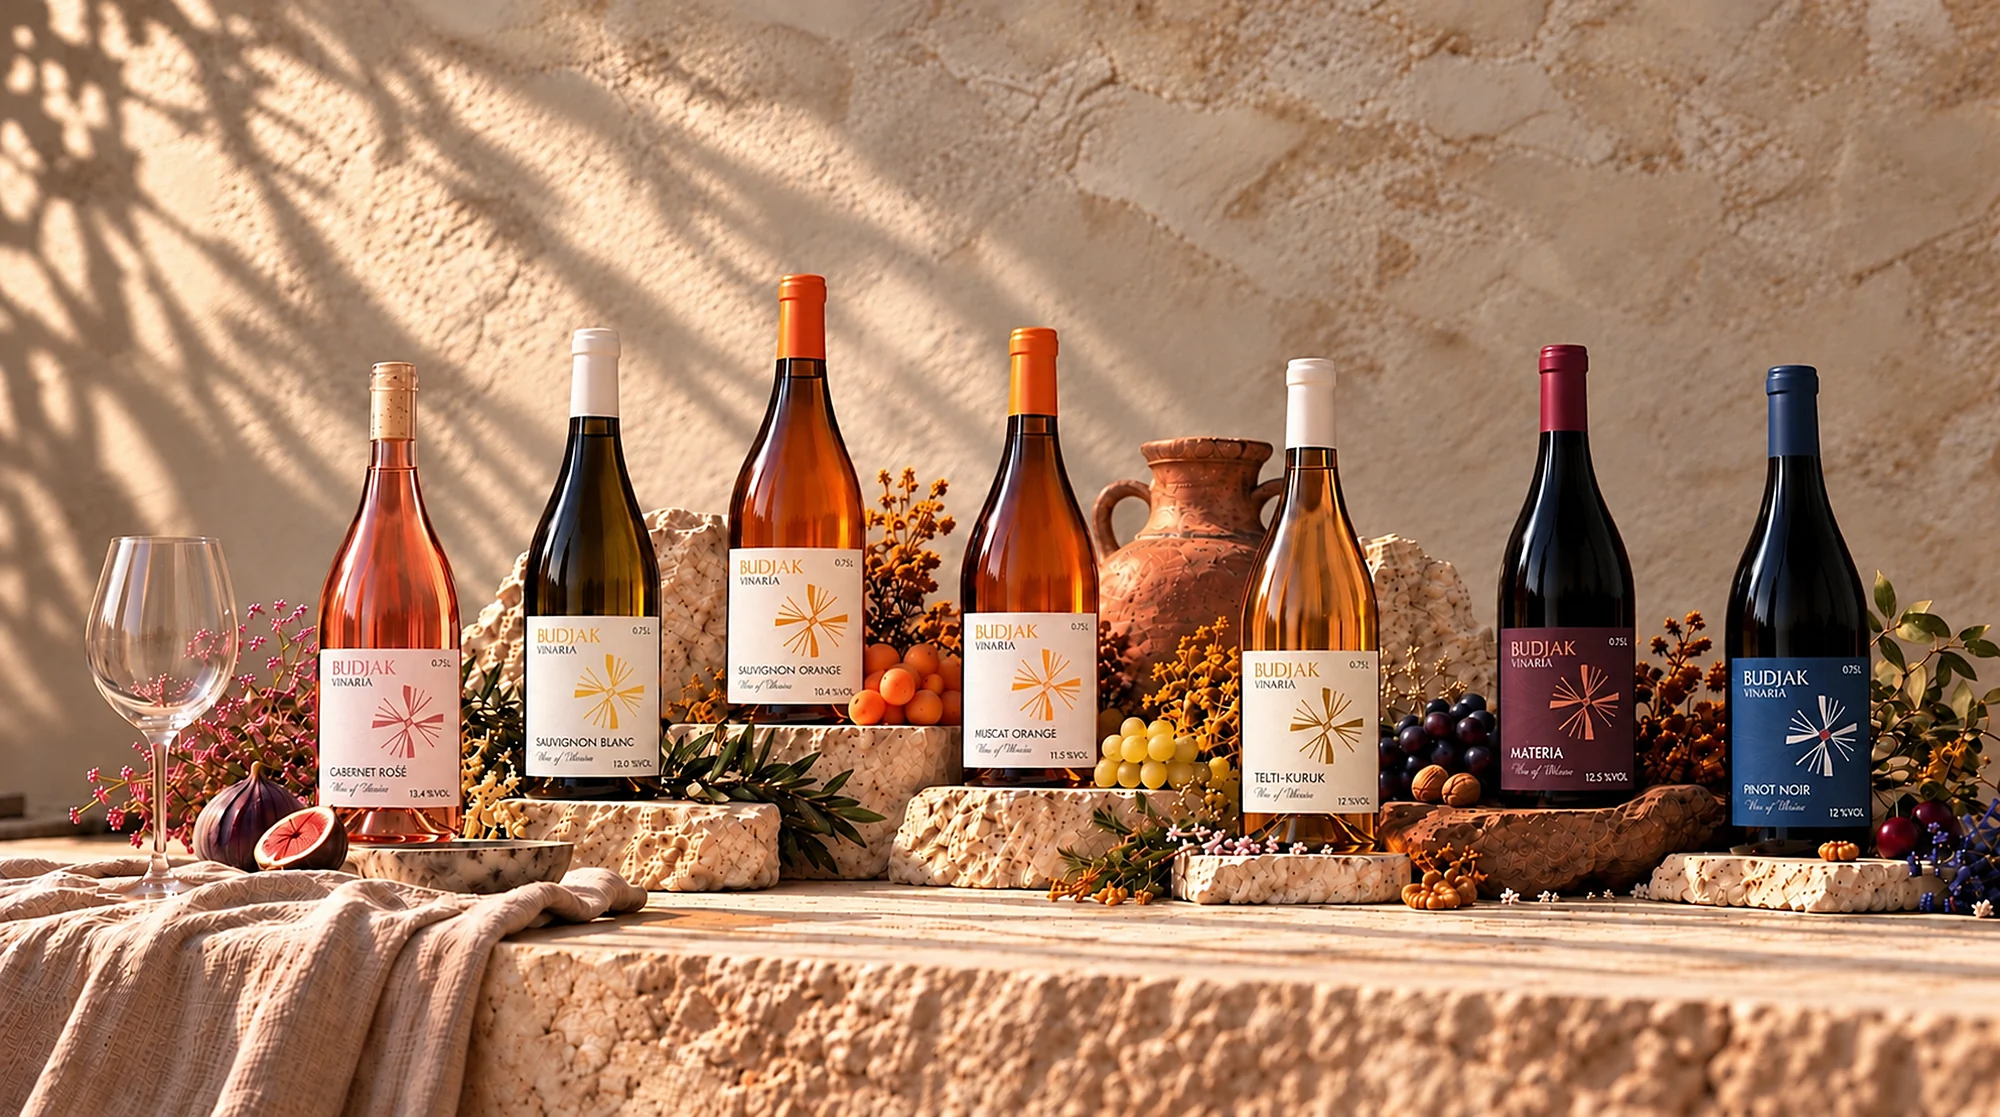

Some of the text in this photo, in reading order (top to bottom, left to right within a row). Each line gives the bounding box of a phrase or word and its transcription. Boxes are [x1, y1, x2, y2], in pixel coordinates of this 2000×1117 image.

[740, 559, 803, 576] BUDJAK
[740, 577, 780, 585] VINARIA
[537, 628, 600, 644] BUDJAK
[975, 624, 1038, 640] BUDJAK
[537, 646, 577, 654] VINARIA
[975, 641, 1016, 650] VINARIA
[1511, 640, 1576, 658] BUDJAK
[333, 660, 396, 676] BUDJAK
[1511, 658, 1552, 668] VINARIA
[738, 665, 841, 675] SAUVIGNON ORANGE
[1255, 662, 1320, 678] BUDJAK
[332, 678, 373, 687] VINARIA
[1743, 670, 1809, 687] BUDJAK
[1255, 680, 1296, 689] VINARIA
[1743, 688, 1786, 698] VINARIA
[975, 729, 1057, 738] MUSCAT ORANGE
[536, 737, 635, 747] SAUVIGNON BLANC
[1510, 747, 1564, 759] MATERIA
[330, 767, 376, 777] CABERNET
[1254, 772, 1325, 783] TELTI-KURUK
[409, 789, 425, 798] 13.4
[1743, 784, 1810, 795] PINOT NOIR
[1338, 797, 1346, 805] 12
[1829, 808, 1838, 817] 12
